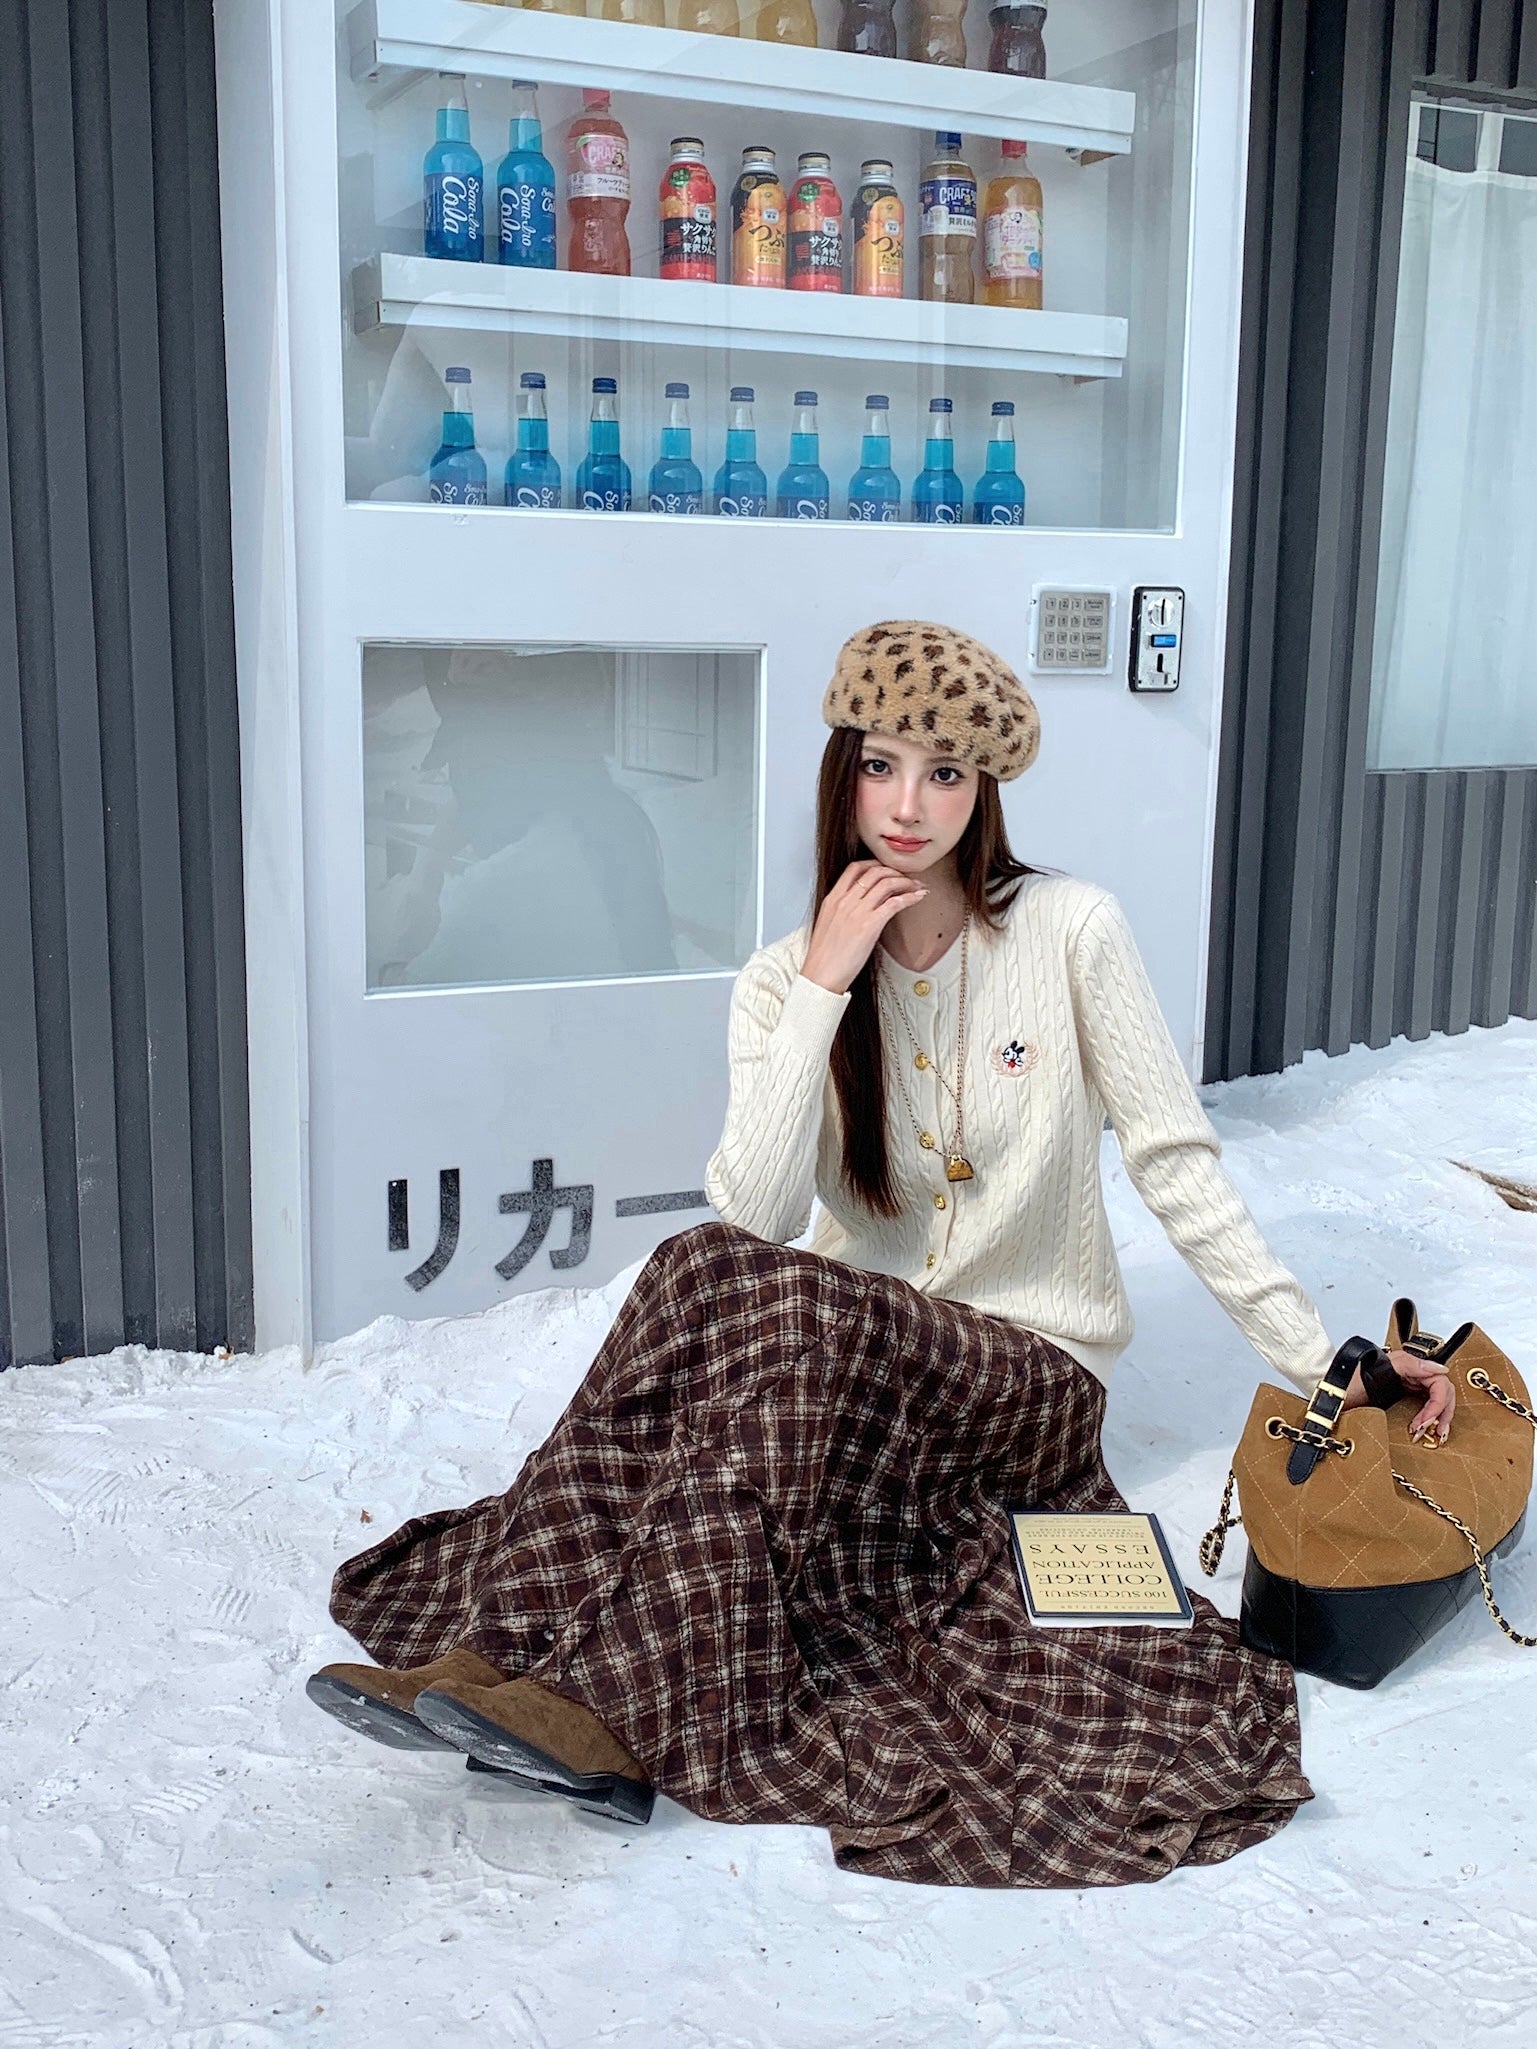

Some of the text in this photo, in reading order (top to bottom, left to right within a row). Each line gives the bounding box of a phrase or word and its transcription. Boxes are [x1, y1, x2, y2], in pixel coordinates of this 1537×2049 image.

[442, 176, 467, 234] Cola
[501, 187, 520, 243] Cola
[1029, 1543, 1151, 1555] ESSAYS
[1032, 1560, 1155, 1569] APPLICATION
[1035, 1574, 1162, 1585] COLLEGE
[1039, 1590, 1168, 1598] 100 SUCCESSFUL
